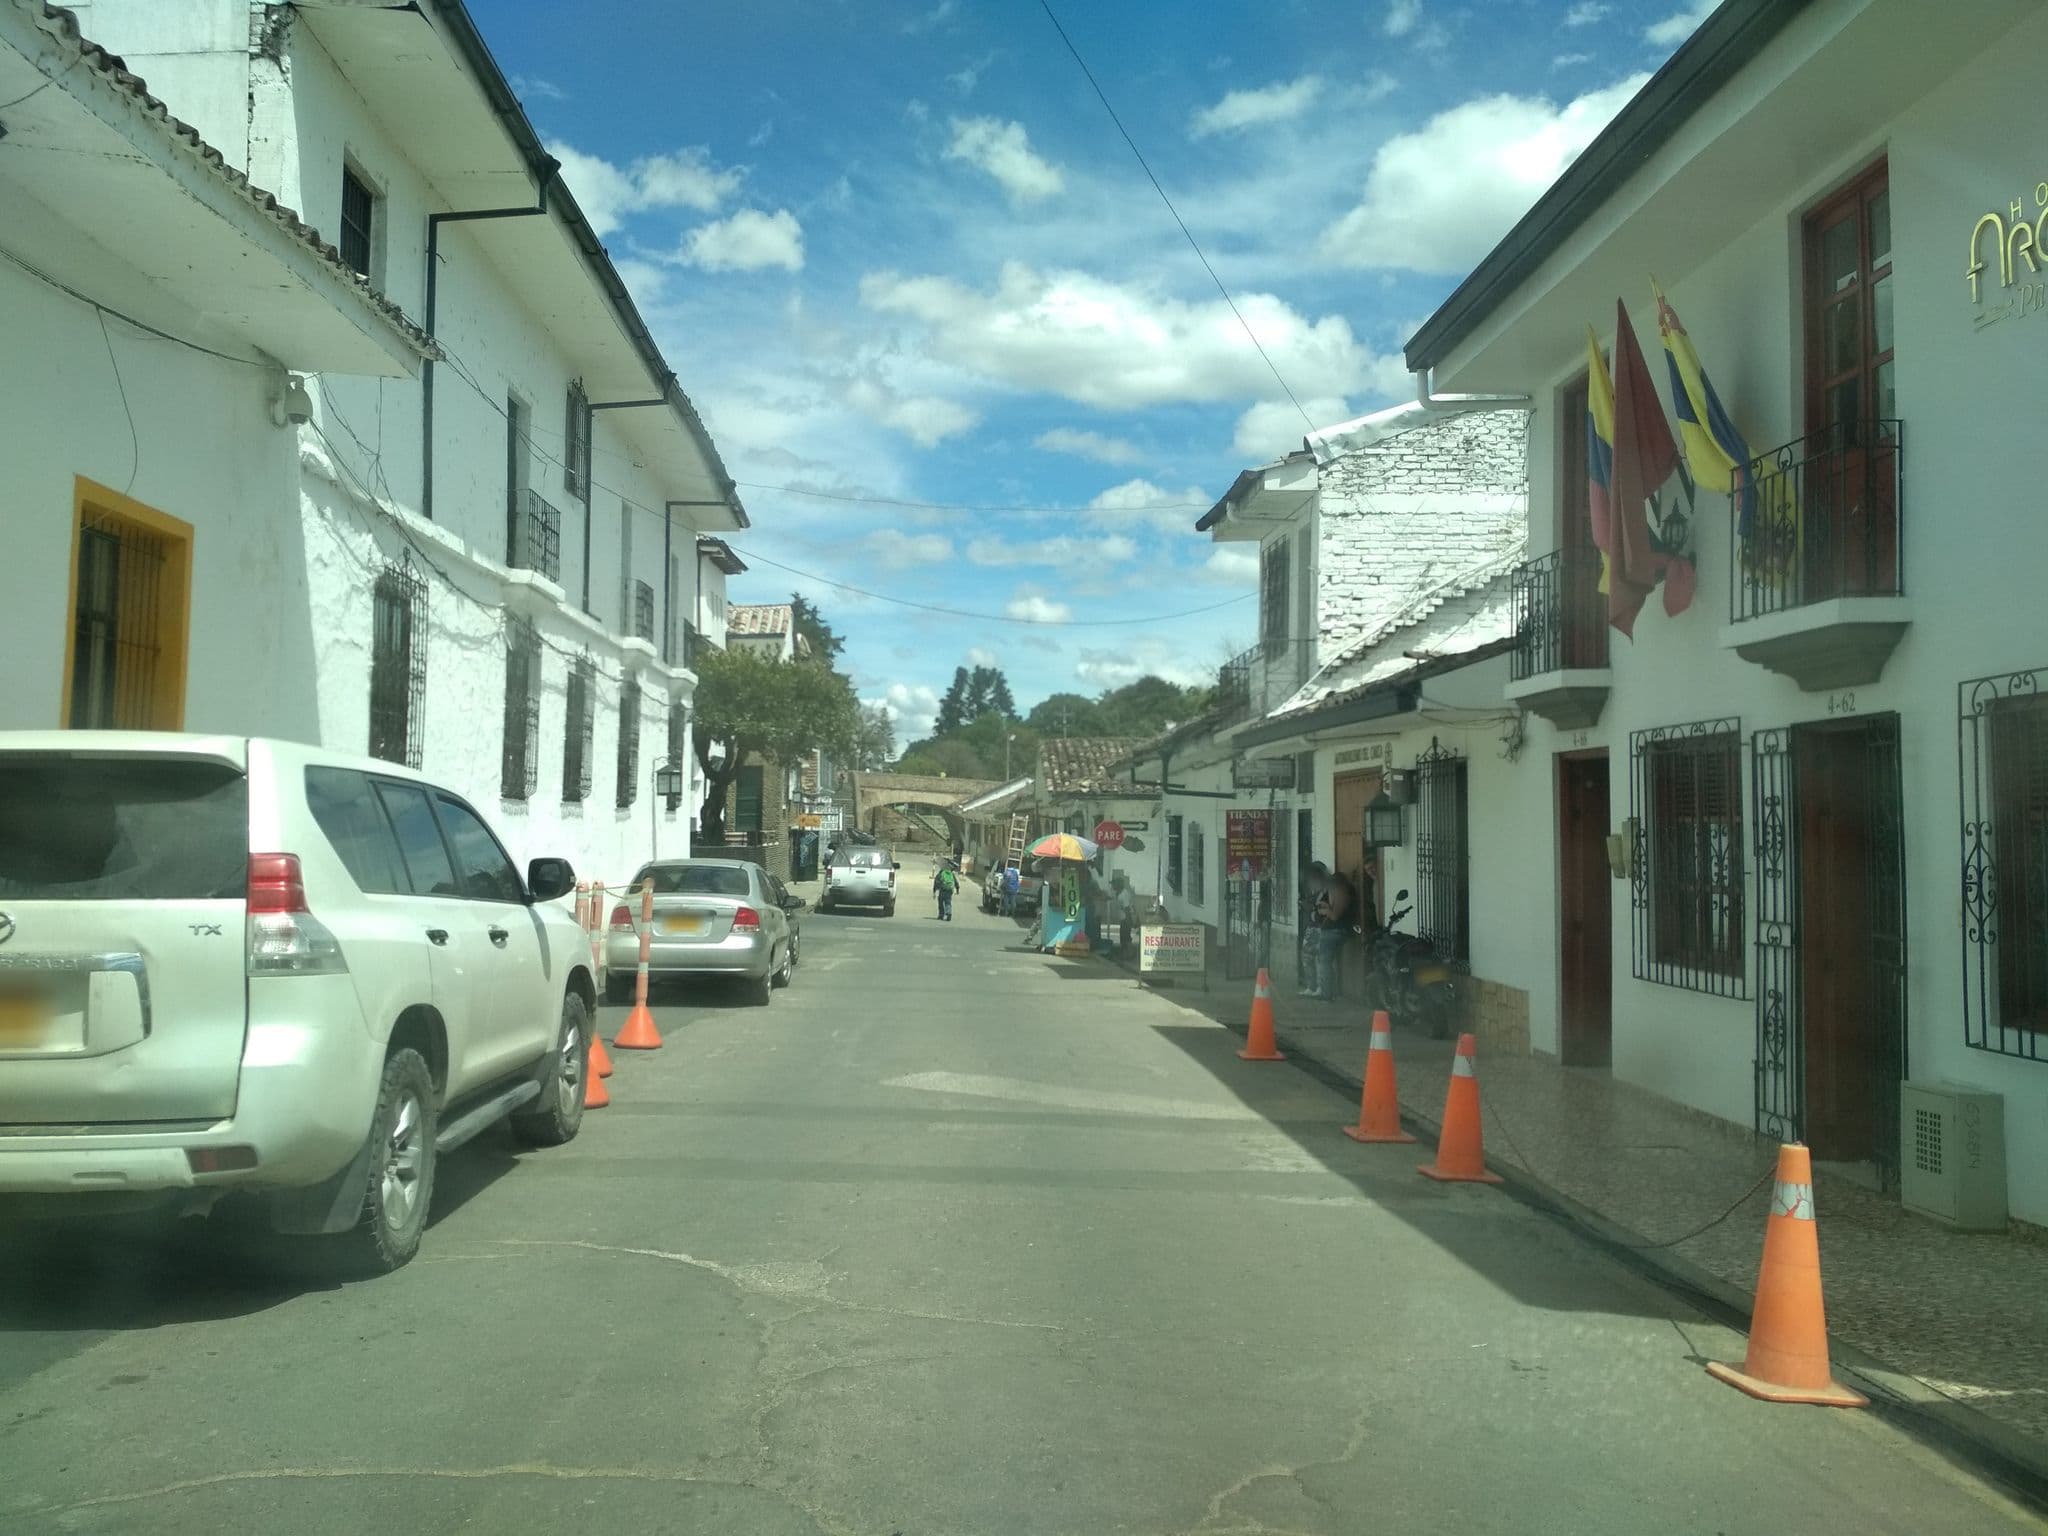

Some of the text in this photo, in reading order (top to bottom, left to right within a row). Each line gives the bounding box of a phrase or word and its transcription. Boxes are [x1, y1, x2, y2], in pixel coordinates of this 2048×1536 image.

[1828, 692, 1856, 714] 4-62
[1230, 811, 1269, 819] TIENDA
[1098, 831, 1121, 841] PARE
[188, 924, 222, 936] TX
[1145, 936, 1200, 948] RESTAURANTE
